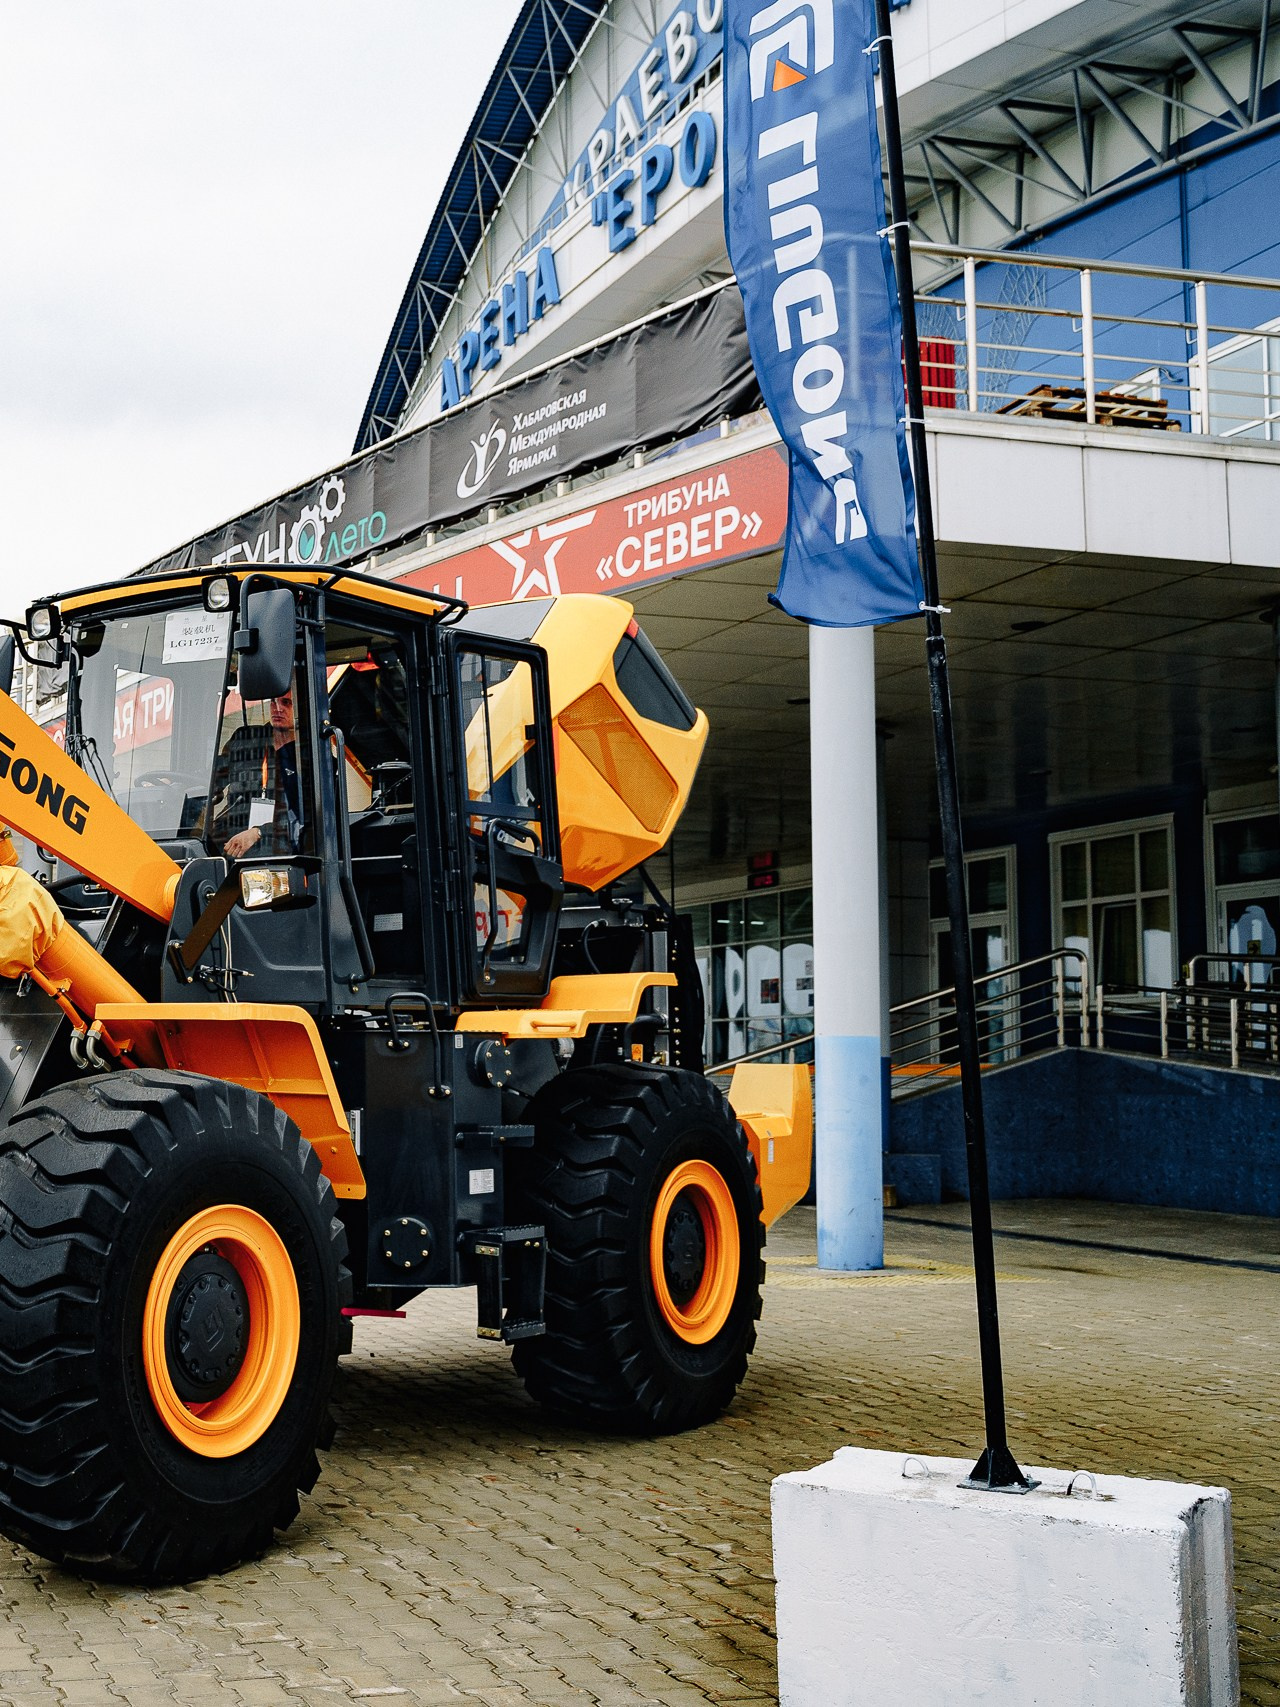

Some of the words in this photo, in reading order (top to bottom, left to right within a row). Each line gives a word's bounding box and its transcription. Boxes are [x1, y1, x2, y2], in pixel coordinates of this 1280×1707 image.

[562, 0, 723, 217] КРАЕВО
[440, 246, 562, 411] АРЕНА
[591, 111, 717, 254] "ЕРО
[623, 473, 731, 528] ТРИБУНА
[595, 505, 763, 582] «СЕВЕР»
[170, 636, 219, 648] LG17237
